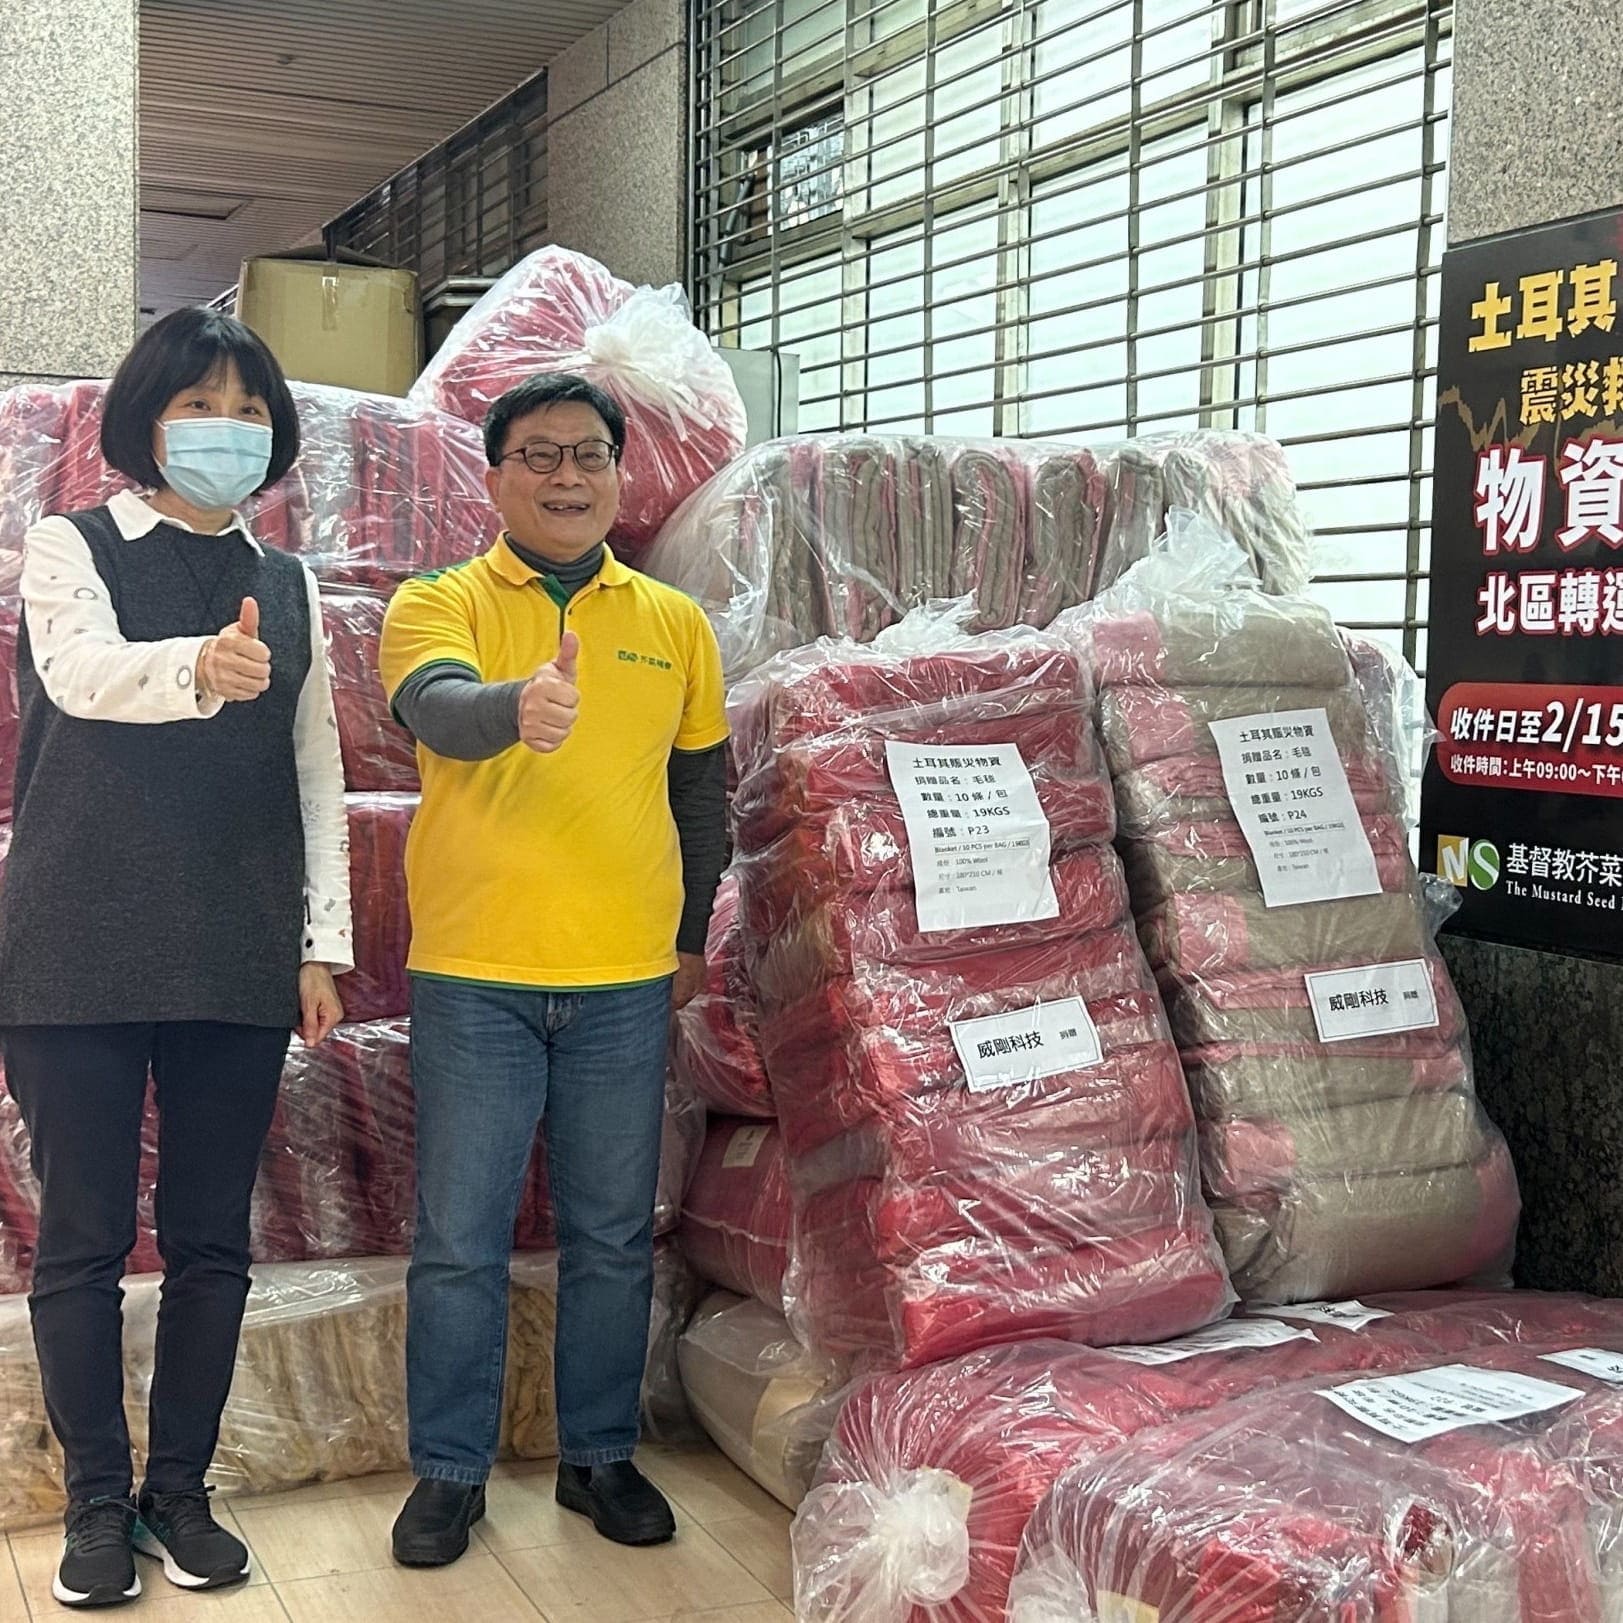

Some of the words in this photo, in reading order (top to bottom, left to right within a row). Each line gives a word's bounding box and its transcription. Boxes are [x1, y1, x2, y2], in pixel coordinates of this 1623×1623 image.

[1468, 259, 1618, 352] 土耳其
[1506, 880, 1527, 897] The
[1531, 883, 1582, 905] Mustard
[1586, 891, 1616, 910] Seed
[1328, 987, 1390, 1012] 威剛科技
[976, 1030, 1045, 1059] 威剛科技
